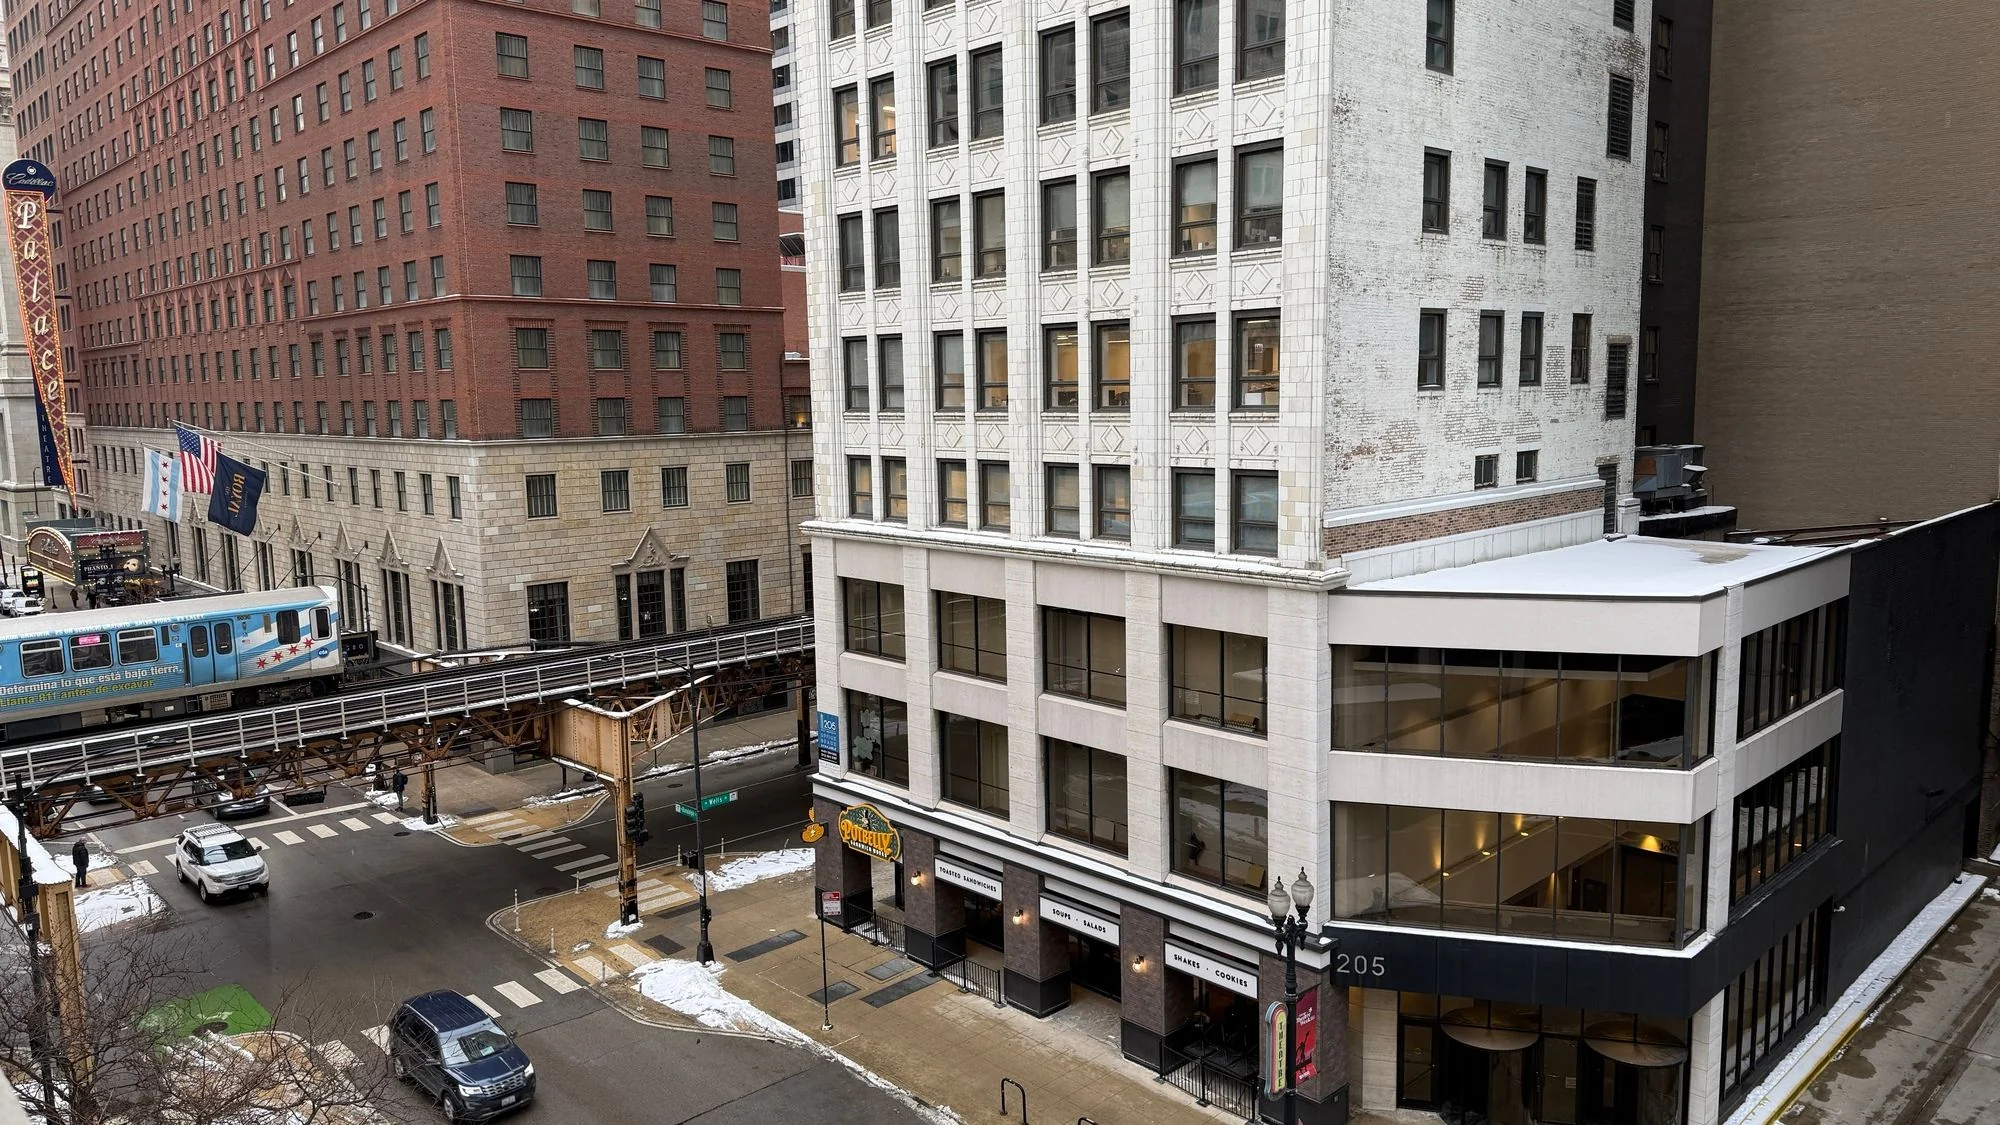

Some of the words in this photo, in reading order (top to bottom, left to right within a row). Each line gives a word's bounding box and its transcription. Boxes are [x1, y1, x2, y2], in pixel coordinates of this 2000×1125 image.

[17, 201, 58, 400] Palace
[41, 414, 51, 483] THEATRE
[60, 687, 92, 699] antes
[95, 684, 109, 694] de
[61, 677, 71, 688] lo
[75, 677, 95, 689] que
[98, 671, 121, 683] está
[125, 668, 148, 680] bajo
[841, 819, 894, 855] POTBELLY
[939, 866, 961, 880] TOASTED
[963, 875, 997, 893] SANDWICHES
[1052, 908, 1072, 921] SOUPS
[1083, 919, 1107, 934] SALADS
[1173, 953, 1201, 969] SHAKES
[1215, 969, 1248, 988] COOKIES
[1336, 953, 1385, 977] 205
